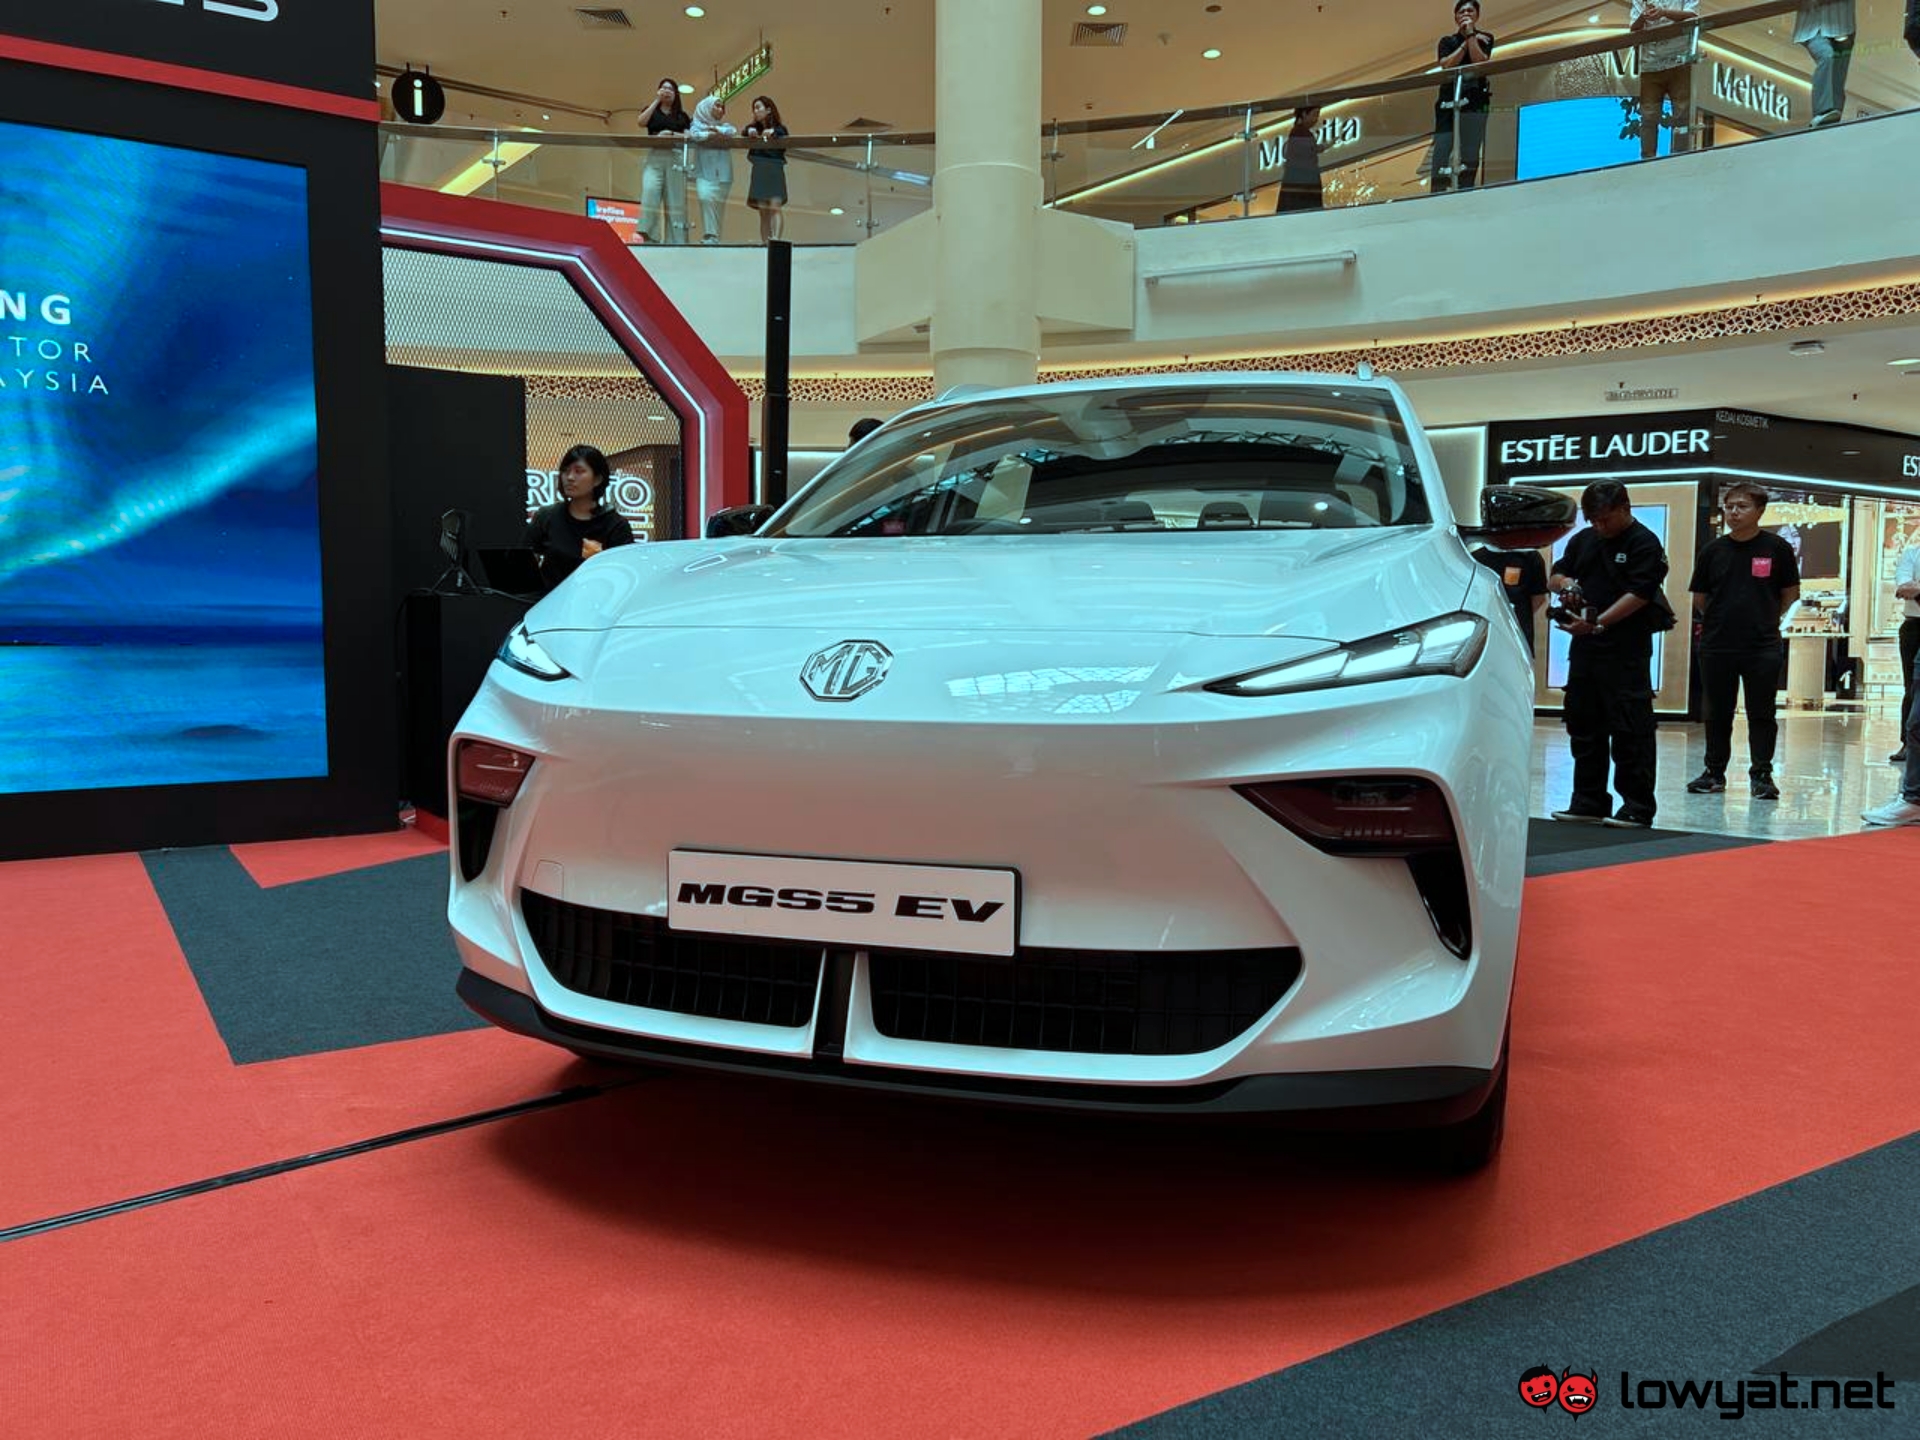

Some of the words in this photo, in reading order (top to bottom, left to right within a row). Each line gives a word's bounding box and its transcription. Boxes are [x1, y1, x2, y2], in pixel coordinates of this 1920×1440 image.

[1713, 62, 1791, 121] Melvita
[8, 336, 92, 363] TOR
[1590, 428, 1710, 459] LAUDER
[805, 643, 885, 695] MG
[677, 882, 875, 914] MGS5
[895, 895, 1005, 923] EV
